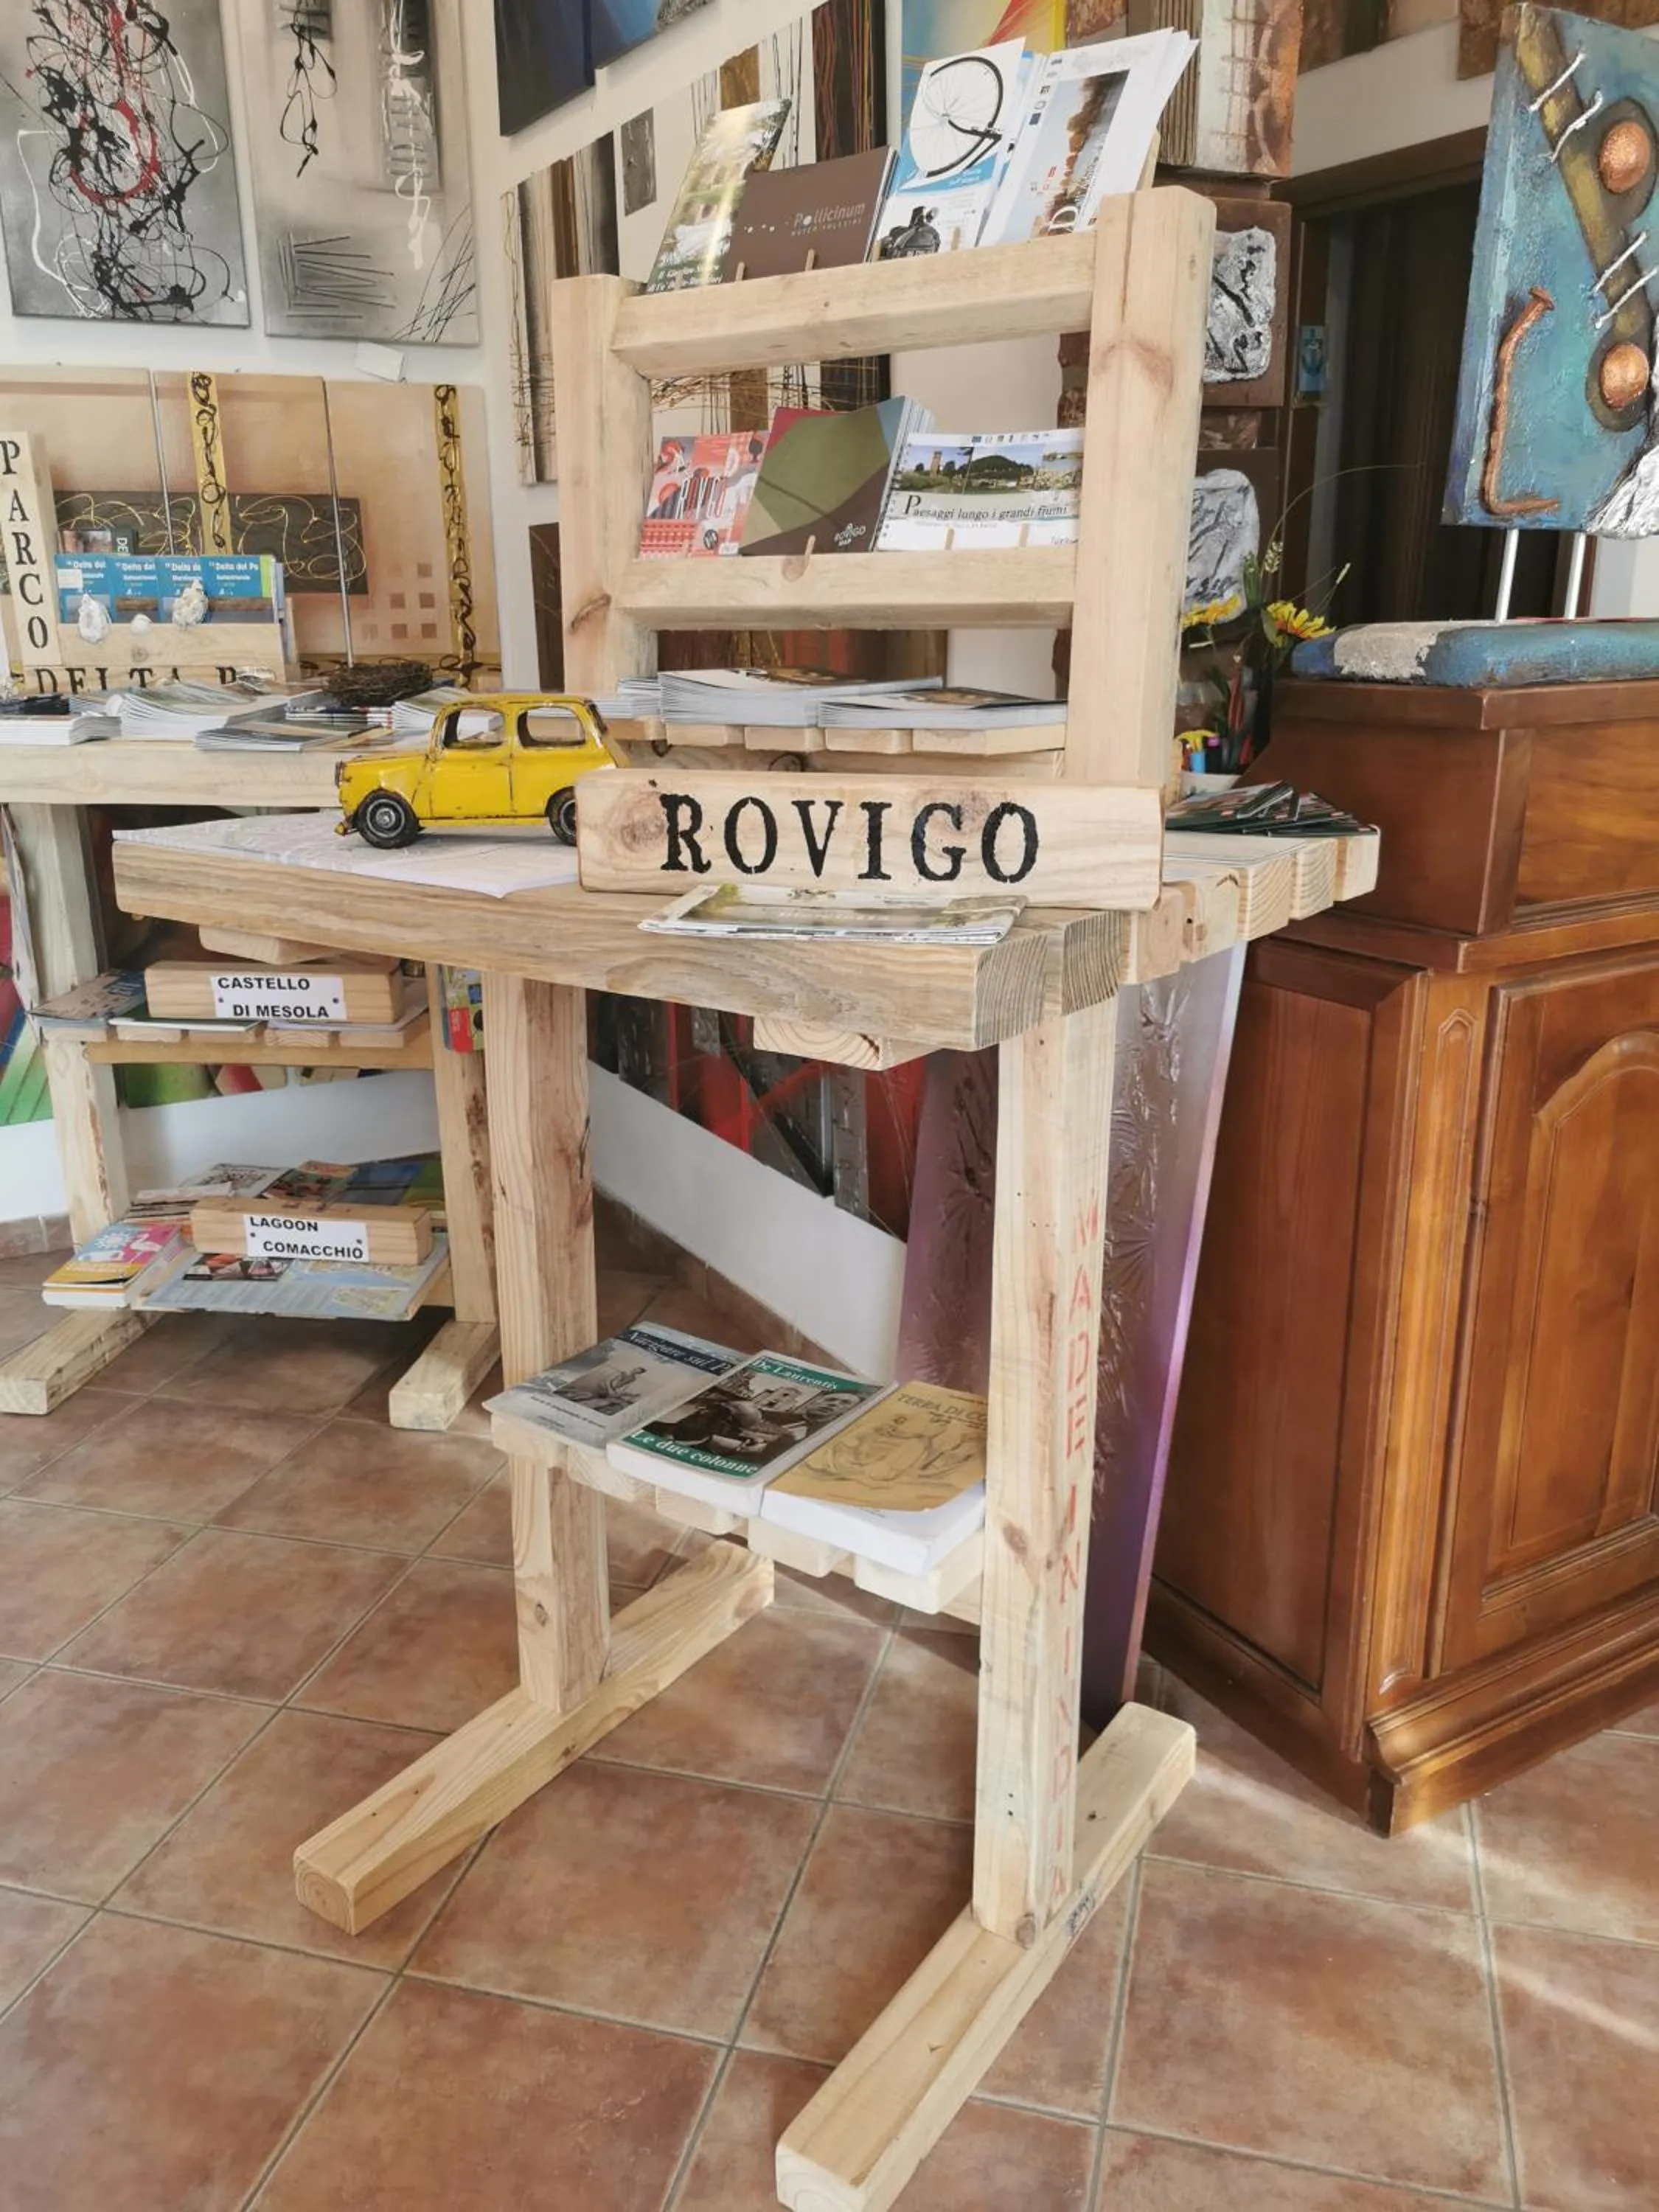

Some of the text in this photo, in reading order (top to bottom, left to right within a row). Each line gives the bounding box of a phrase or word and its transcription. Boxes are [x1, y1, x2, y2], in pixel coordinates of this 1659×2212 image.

[904, 495, 955, 521] Paesaggi
[958, 507, 990, 521] lungo
[998, 505, 1034, 521] grandi
[1, 439, 49, 650] PARCO
[659, 793, 1039, 883] ROVIGO
[218, 977, 310, 990] CASTELLO
[233, 1004, 329, 1018] DI MESOLA
[249, 1217, 319, 1232] LAGOON
[262, 1240, 364, 1259] COMACCHIO
[1067, 1203, 1099, 1461] MADE
[630, 1429, 759, 1473] Le due colonne
